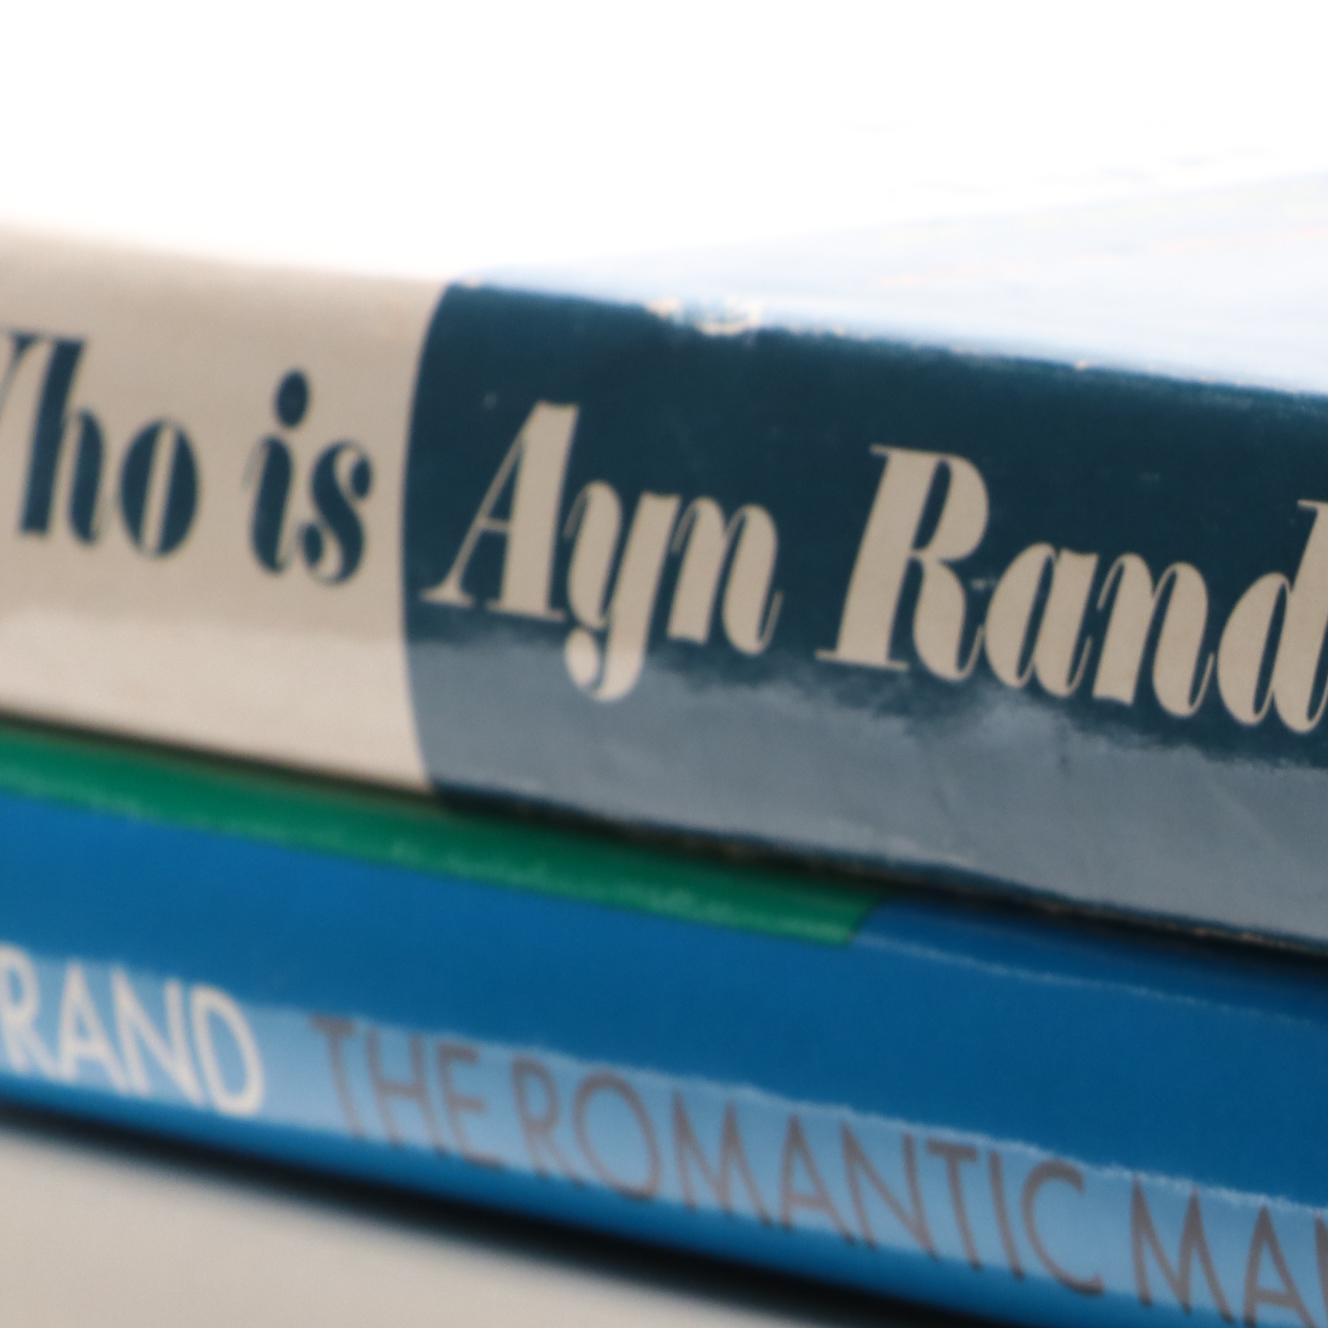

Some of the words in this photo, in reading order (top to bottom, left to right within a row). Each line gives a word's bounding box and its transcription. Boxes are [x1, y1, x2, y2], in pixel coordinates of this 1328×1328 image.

[0, 328, 199, 558] ho
[243, 369, 373, 585] is
[421, 400, 783, 701] Ayn
[0, 941, 263, 1116] RAND
[311, 1014, 506, 1169] THE
[509, 1055, 1103, 1298] ROMANTIC
